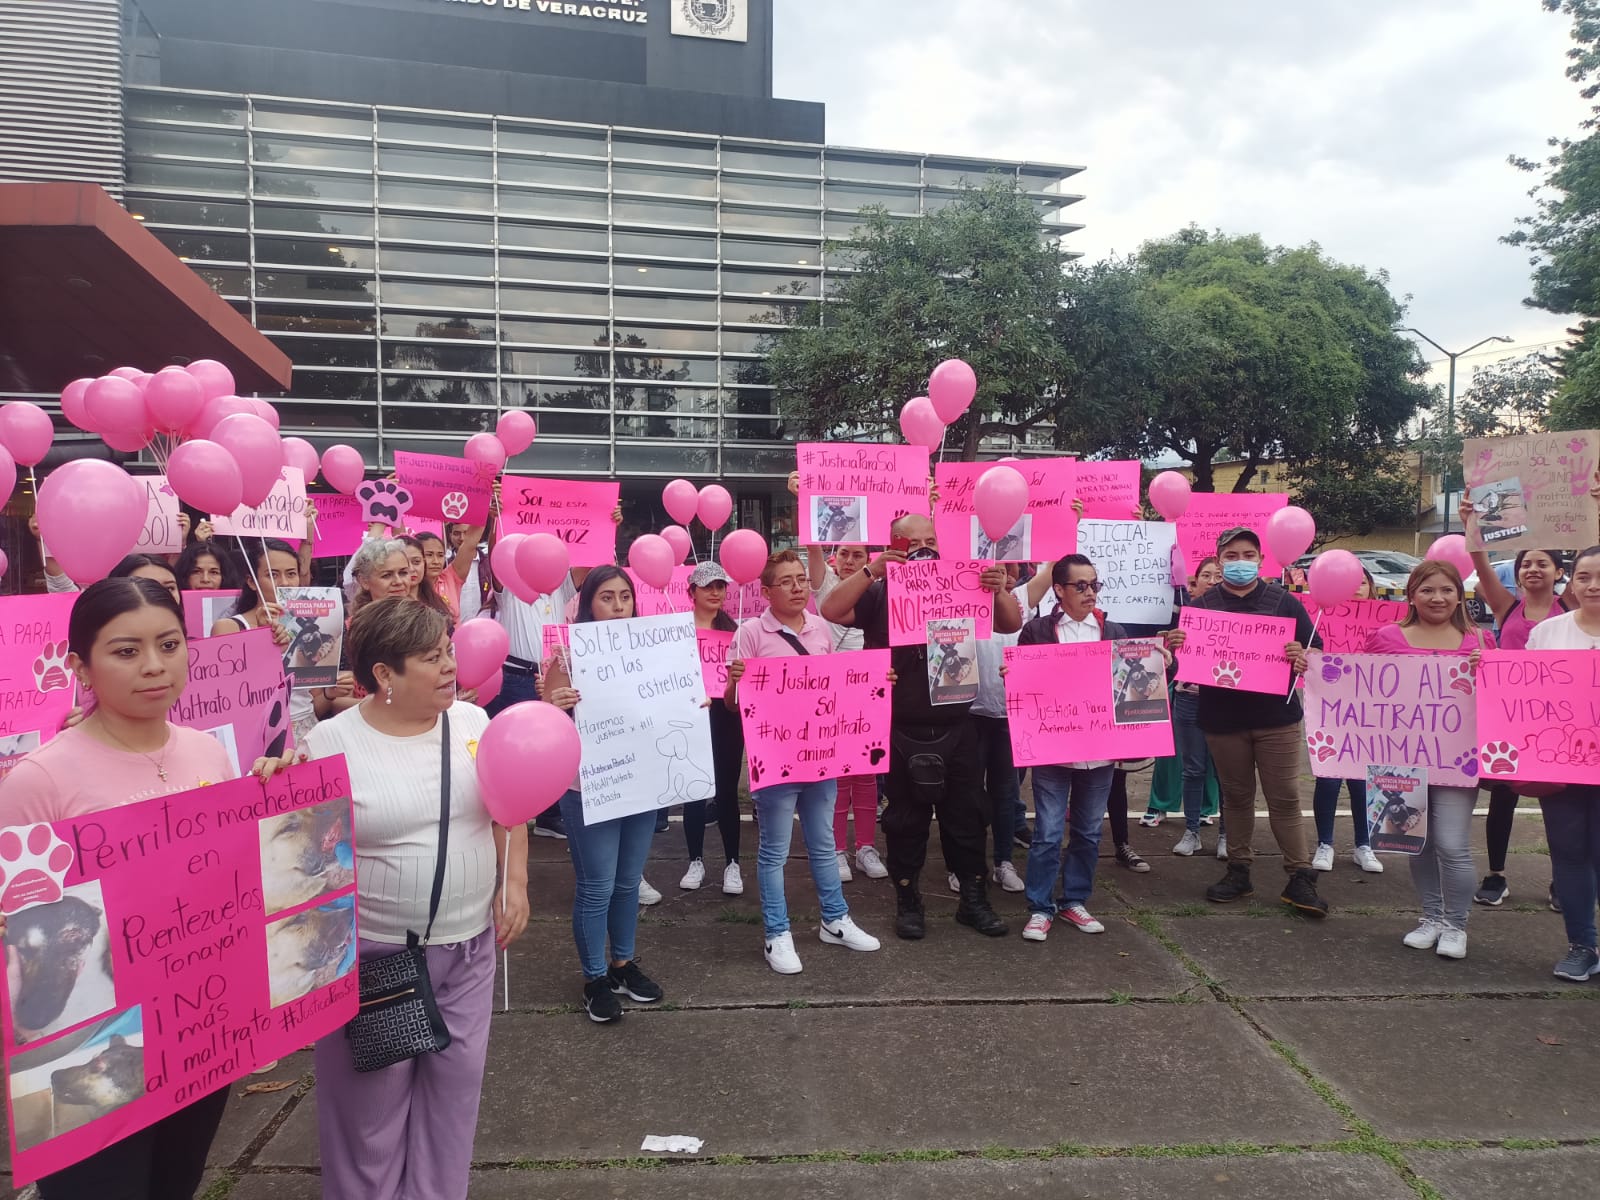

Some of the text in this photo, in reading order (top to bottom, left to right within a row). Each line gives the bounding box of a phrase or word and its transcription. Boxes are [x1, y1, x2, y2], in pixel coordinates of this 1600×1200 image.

[536, 1, 648, 23] VERACRUZ
[1529, 456, 1550, 467] SOL
[897, 477, 928, 496] Animal
[1027, 491, 1065, 508] animal
[242, 511, 293, 533] animal
[517, 510, 590, 527] SOLA NOSOTROS
[1554, 523, 1576, 533] SOL
[556, 529, 589, 544] VOZ
[1483, 524, 1528, 541] JUSTICIA
[1137, 542, 1154, 555] DE
[889, 562, 939, 583] #JUSTICIA
[1108, 560, 1127, 572] DE
[1134, 557, 1168, 571] EDAD
[905, 576, 960, 594] PARA SOL
[891, 593, 953, 635] NO! MAS
[922, 603, 990, 621] MALTRATO
[15, 621, 52, 645] PARA
[606, 628, 622, 652] te
[626, 621, 696, 650] buscaremos
[1318, 622, 1336, 638] AL
[1180, 644, 1192, 655] NO
[1195, 646, 1206, 657] AL
[1213, 649, 1262, 661] MALTRATO
[597, 656, 643, 682] en las
[638, 673, 694, 699] estrellas
[1354, 662, 1456, 700] NO AL
[815, 691, 836, 716] Sol
[1083, 700, 1108, 714] Para
[1501, 698, 1574, 722] VIDAS
[578, 715, 625, 735] Haremos
[797, 721, 808, 741] al
[818, 710, 871, 739] maltrato
[1320, 697, 1462, 733] MALTRATO
[797, 741, 836, 762] animal
[1337, 732, 1456, 770] ANIMAL
[72, 765, 344, 877] Perritos macheteados
[188, 849, 220, 874] en
[158, 923, 248, 979] Tonayán
[178, 1001, 230, 1043] más
[146, 1050, 169, 1093] al
[183, 1007, 271, 1073] maltrato
